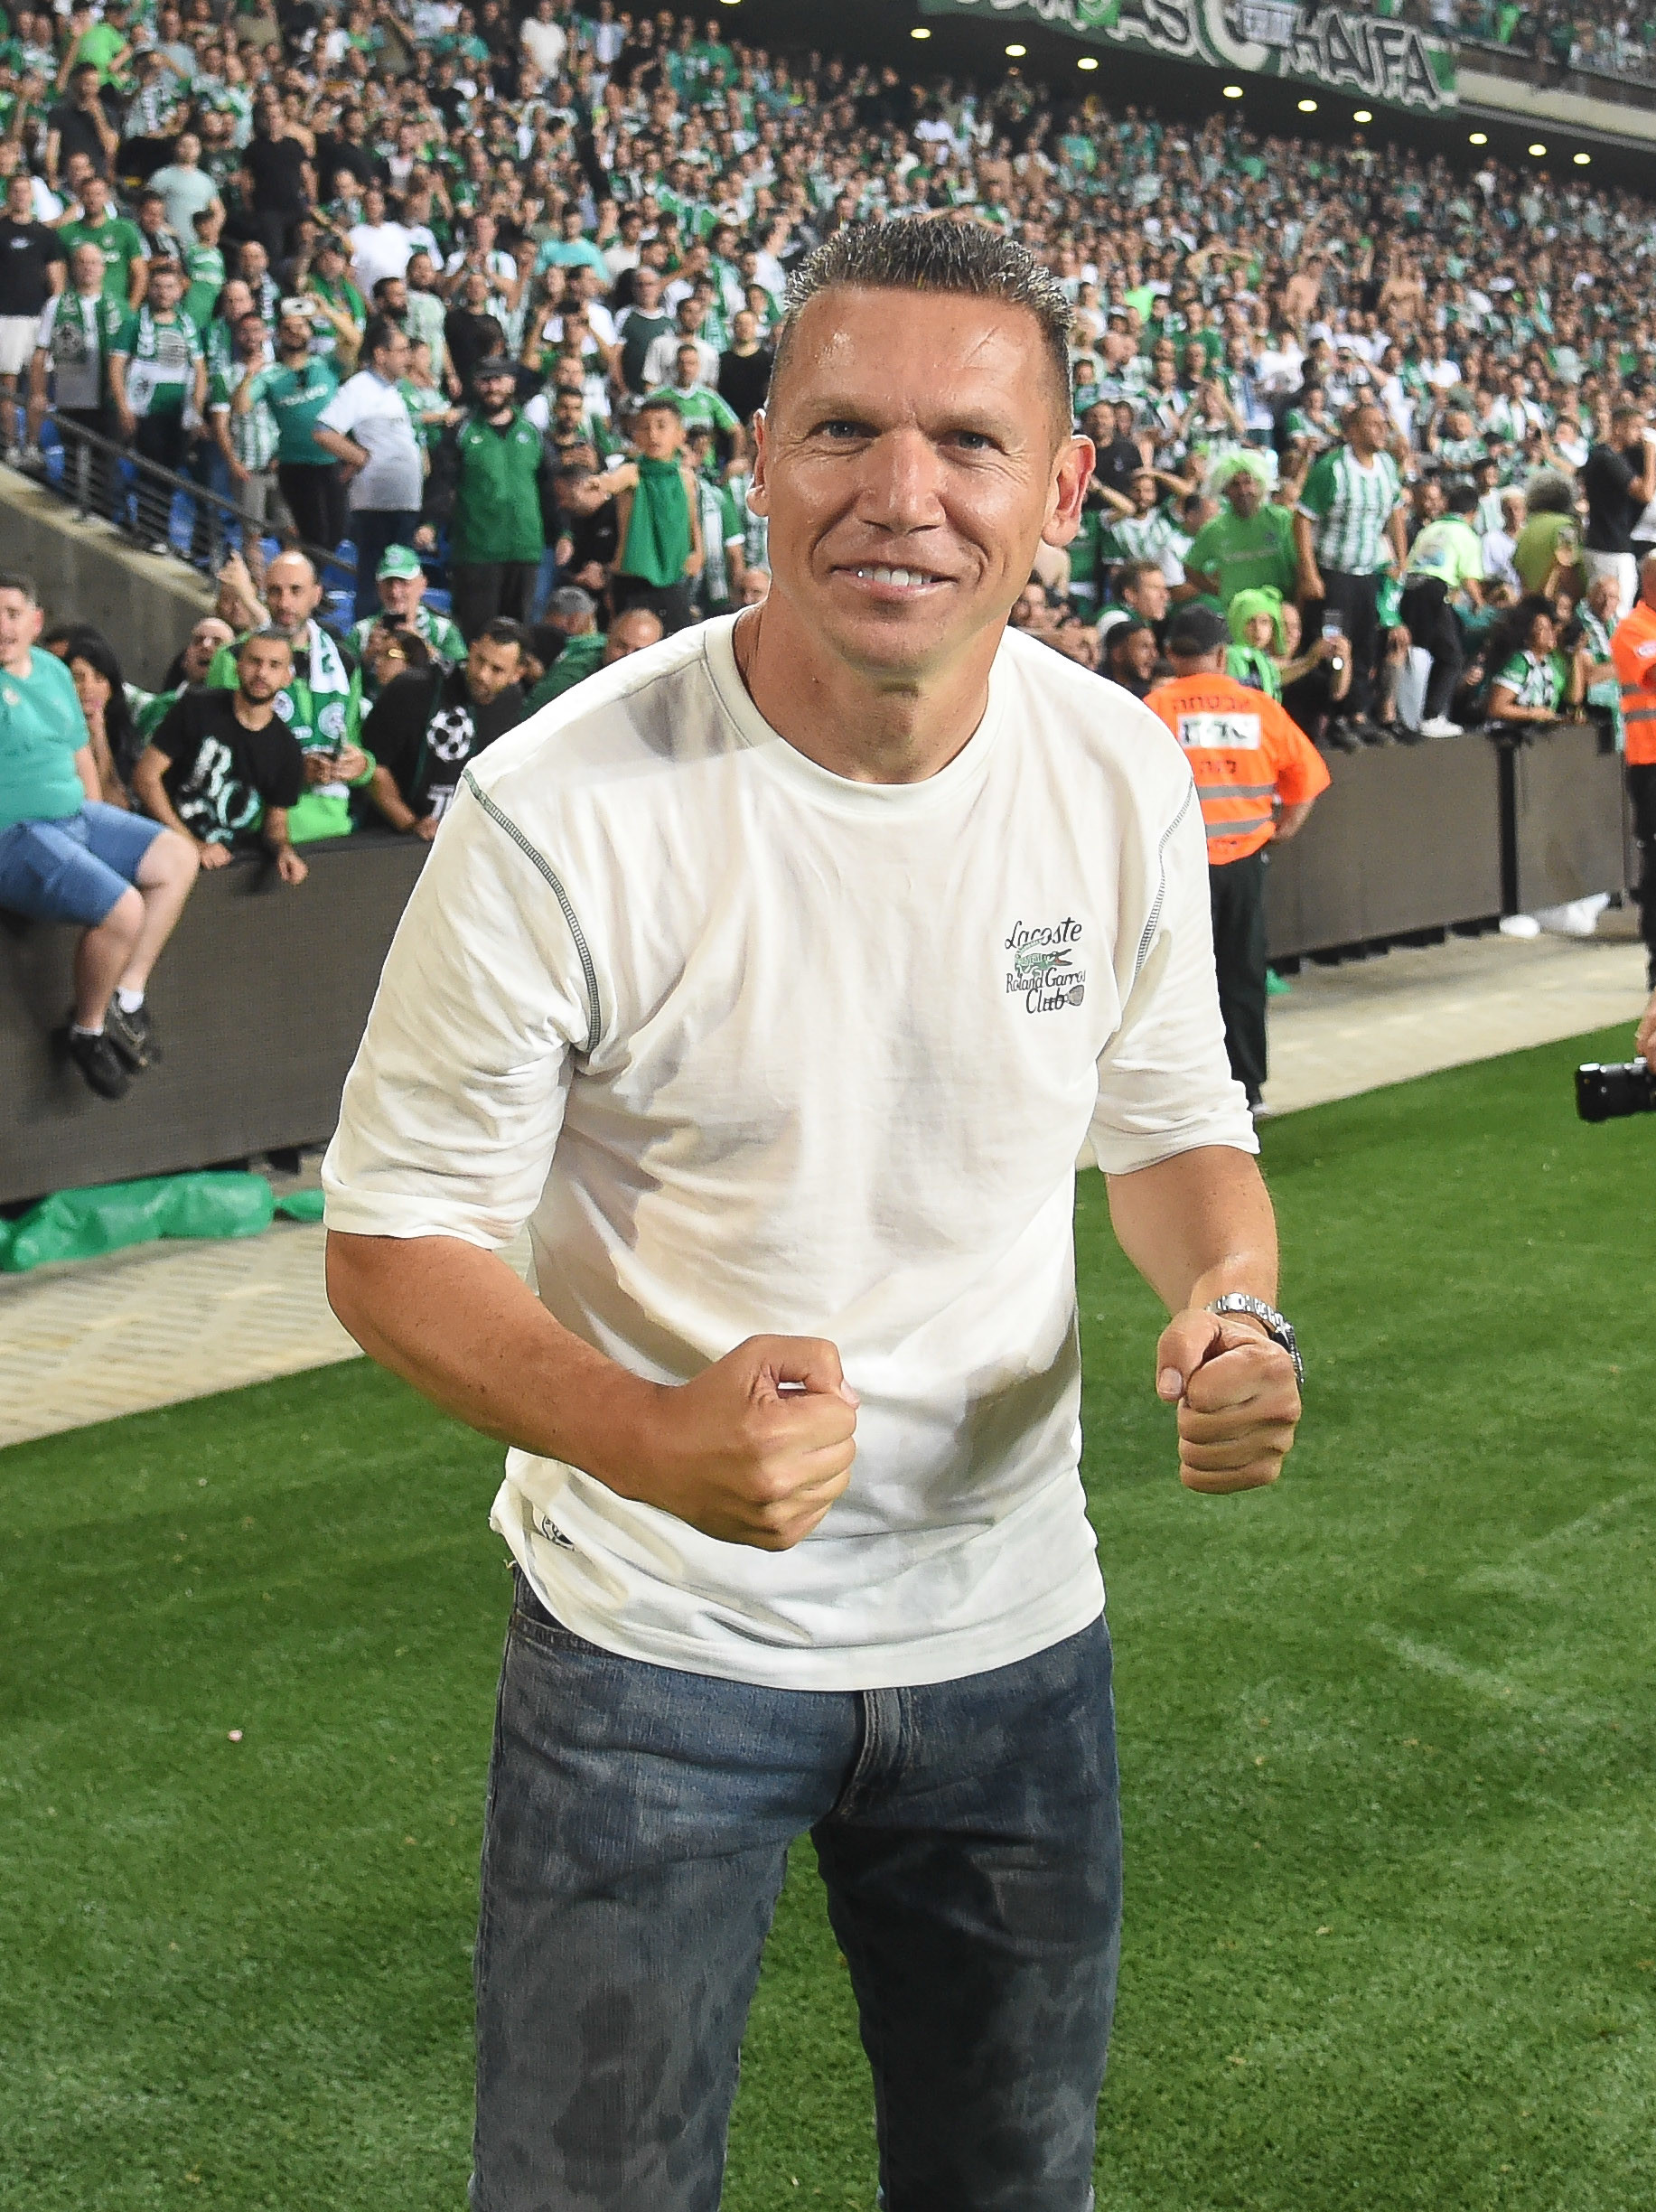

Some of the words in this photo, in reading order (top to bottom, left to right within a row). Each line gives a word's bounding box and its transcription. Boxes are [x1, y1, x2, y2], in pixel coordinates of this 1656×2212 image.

[1005, 916, 1082, 950] Lacoste
[1006, 971, 1043, 993] Roland
[1025, 987, 1065, 1014] Club
